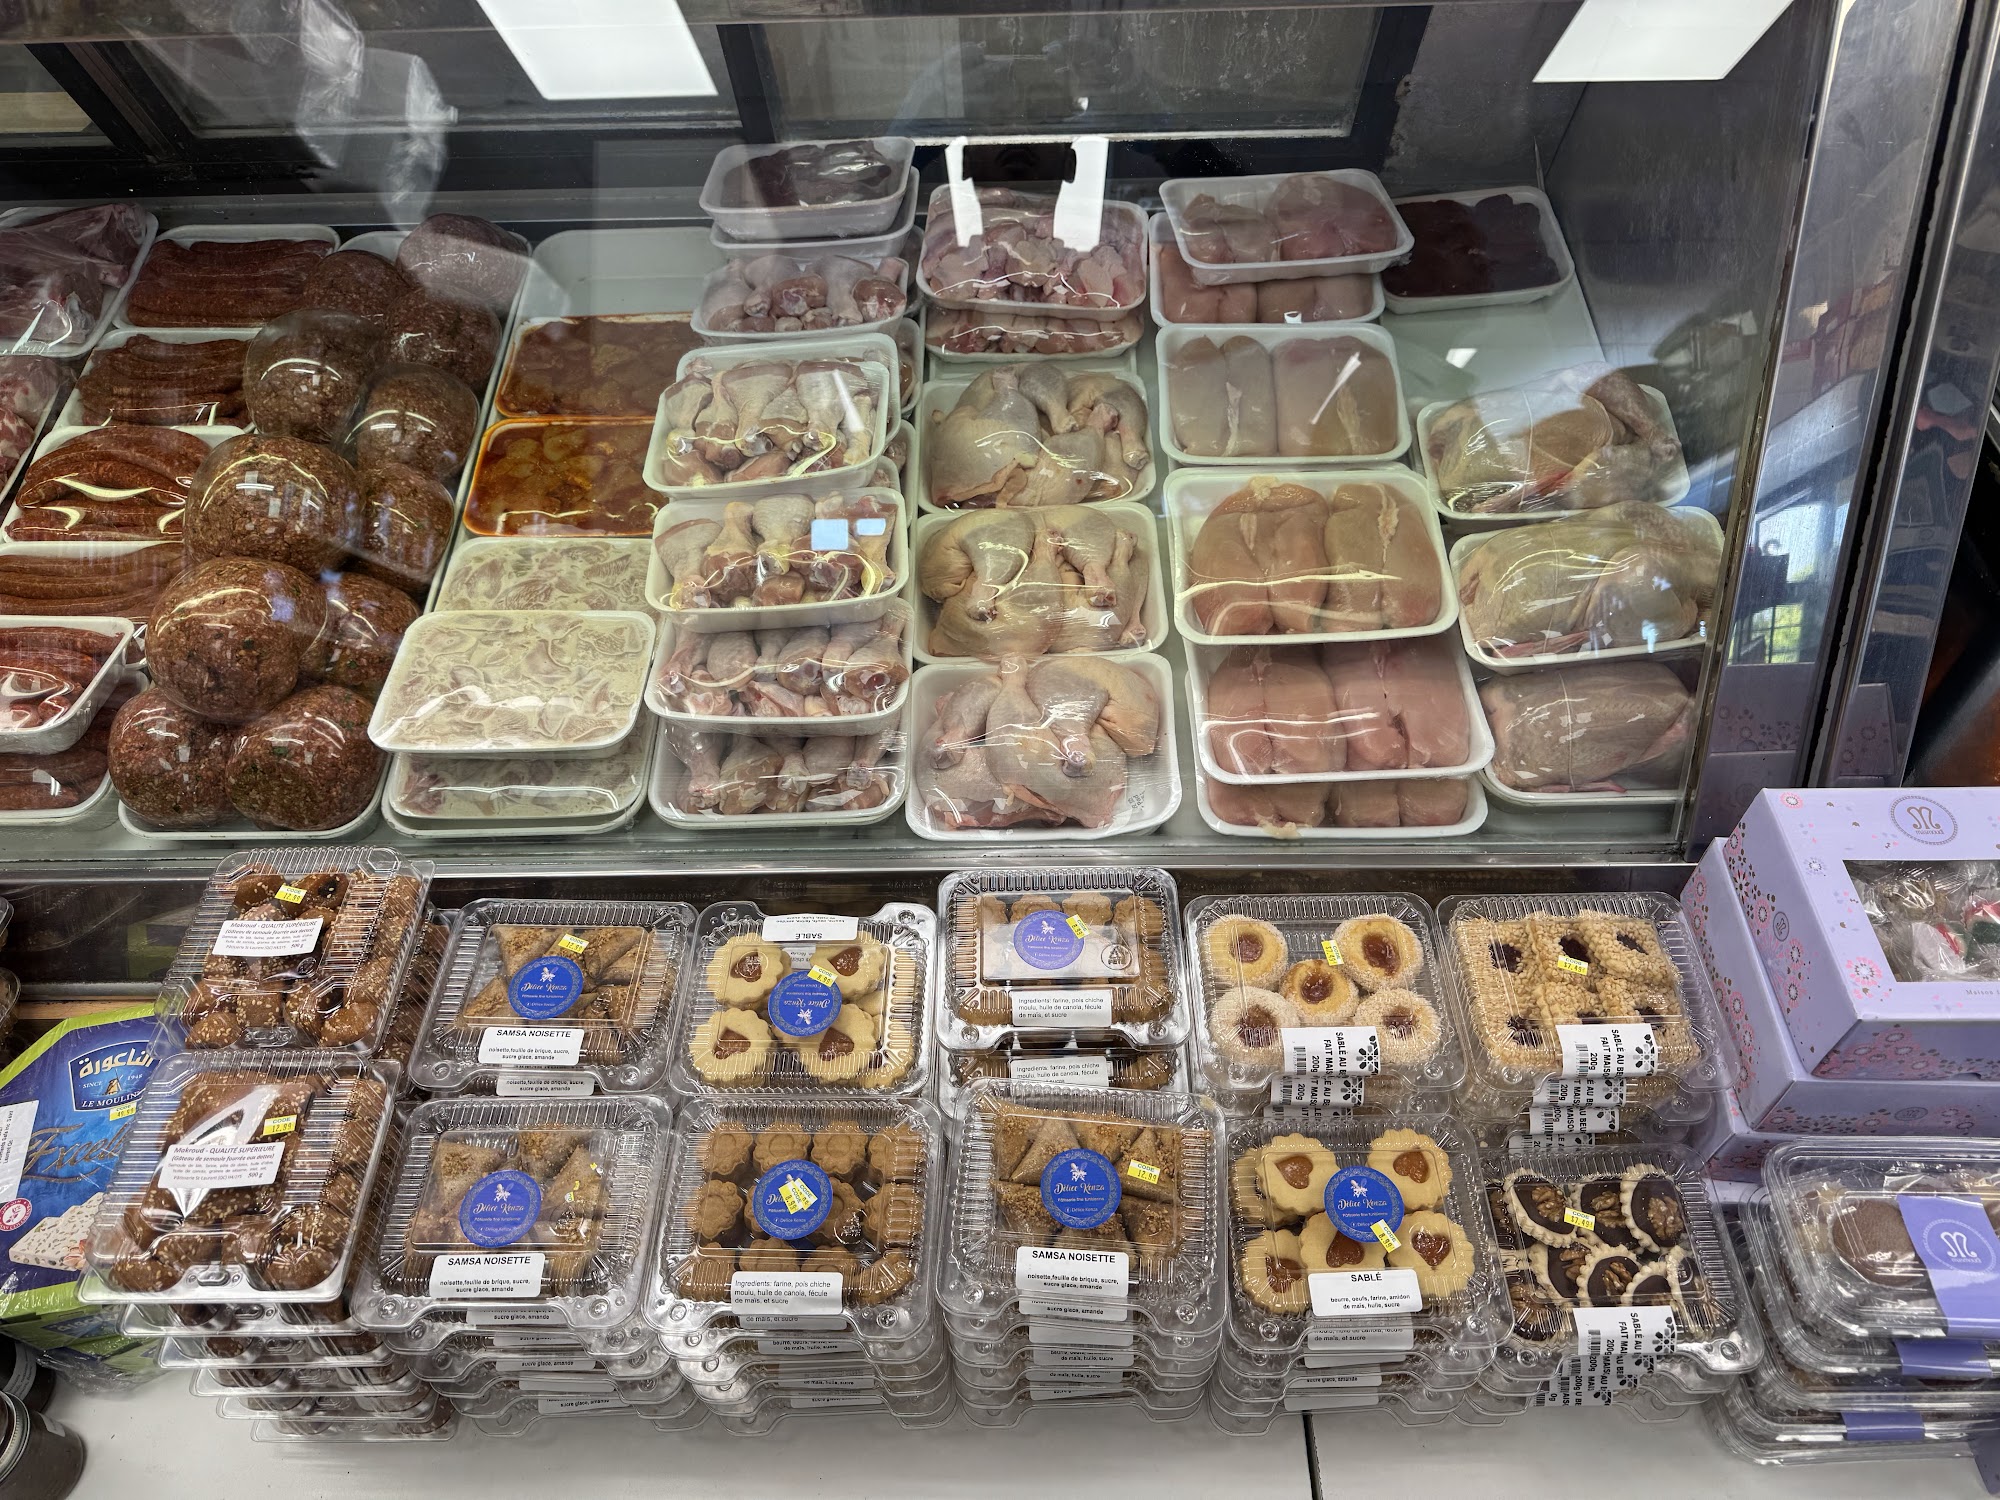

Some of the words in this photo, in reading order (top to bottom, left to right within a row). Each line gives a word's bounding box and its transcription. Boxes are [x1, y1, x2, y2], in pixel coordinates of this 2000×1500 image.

[795, 932, 823, 940] SABLÉ
[496, 1029, 527, 1037] SAMSA
[529, 1030, 571, 1038] NOISETTE
[1335, 1031, 1348, 1055] SABLÉ
[1600, 1036, 1611, 1053] FAIT
[1611, 1029, 1625, 1053] SABLÉ
[1323, 1039, 1333, 1056] FAIT
[1310, 1055, 1320, 1073] 200g
[1338, 1056, 1347, 1067] AU
[1588, 1052, 1598, 1071] 200g
[1617, 1054, 1625, 1065] AU
[1296, 1083, 1305, 1101] 200g
[1323, 1086, 1331, 1097] AU
[1558, 1084, 1568, 1101] 200g
[1586, 1085, 1594, 1097] AU
[81, 1100, 96, 1108] LE
[272, 1122, 292, 1133] 12.99
[209, 1146, 239, 1155] QUALITÉ
[1137, 1163, 1155, 1173] CODE
[1137, 1169, 1157, 1182] 12.99
[1080, 1182, 1105, 1195] Kenza
[500, 1203, 525, 1215] Kenza
[1362, 1198, 1387, 1210] Kenza
[447, 1257, 482, 1266] SAMSA
[483, 1256, 531, 1265] NOISETTE
[1031, 1250, 1067, 1260] SAMSA
[1068, 1252, 1116, 1263] NOISETTE
[491, 1278, 511, 1286] brique,
[1079, 1276, 1100, 1284] brique,
[1351, 1271, 1383, 1282] SABLÉ
[735, 1280, 772, 1288] Ingredients:
[773, 1280, 794, 1288] farine,
[783, 1289, 807, 1297] canola,
[808, 1289, 828, 1297] fécule
[1618, 1321, 1629, 1340] FAIT
[1630, 1312, 1645, 1339] SABLÉ
[1604, 1339, 1615, 1356] 200g
[1634, 1340, 1642, 1351] AU
[1588, 1355, 1597, 1372] 200g
